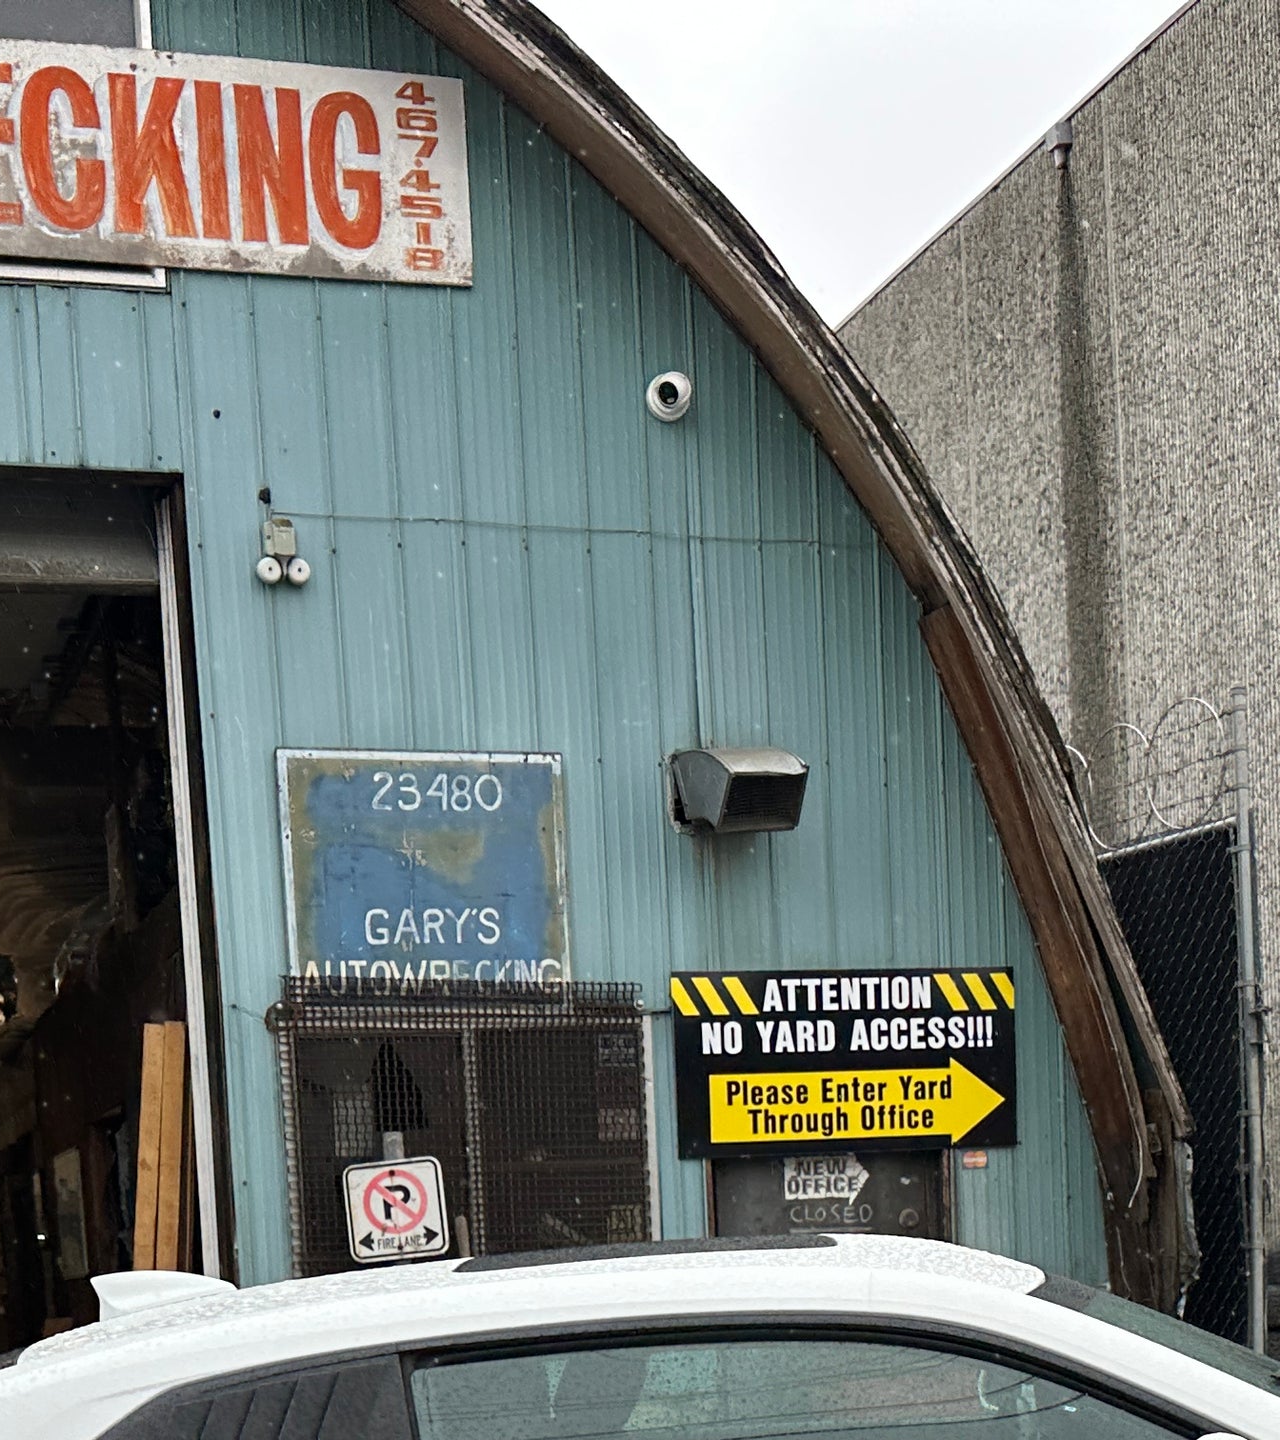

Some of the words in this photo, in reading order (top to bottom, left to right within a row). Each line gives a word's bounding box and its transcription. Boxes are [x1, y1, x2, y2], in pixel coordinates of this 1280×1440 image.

[371, 770, 503, 812] 23480
[364, 907, 501, 945] GARY'S
[762, 975, 933, 1013] ATTENTION
[700, 1020, 744, 1056] NO
[756, 1018, 837, 1054] YARD
[849, 1015, 994, 1052] ACCESS!!!
[726, 1079, 809, 1107] Please
[820, 1076, 888, 1104] Enter
[898, 1073, 953, 1101] Yard
[747, 1106, 849, 1137] Through
[860, 1104, 935, 1132] Office
[794, 1157, 847, 1177] NEW
[786, 1175, 860, 1196] OFFICE
[789, 1202, 874, 1224] CLOSED
[377, 1236, 397, 1250] FIRE
[398, 1233, 423, 1249] LANE
